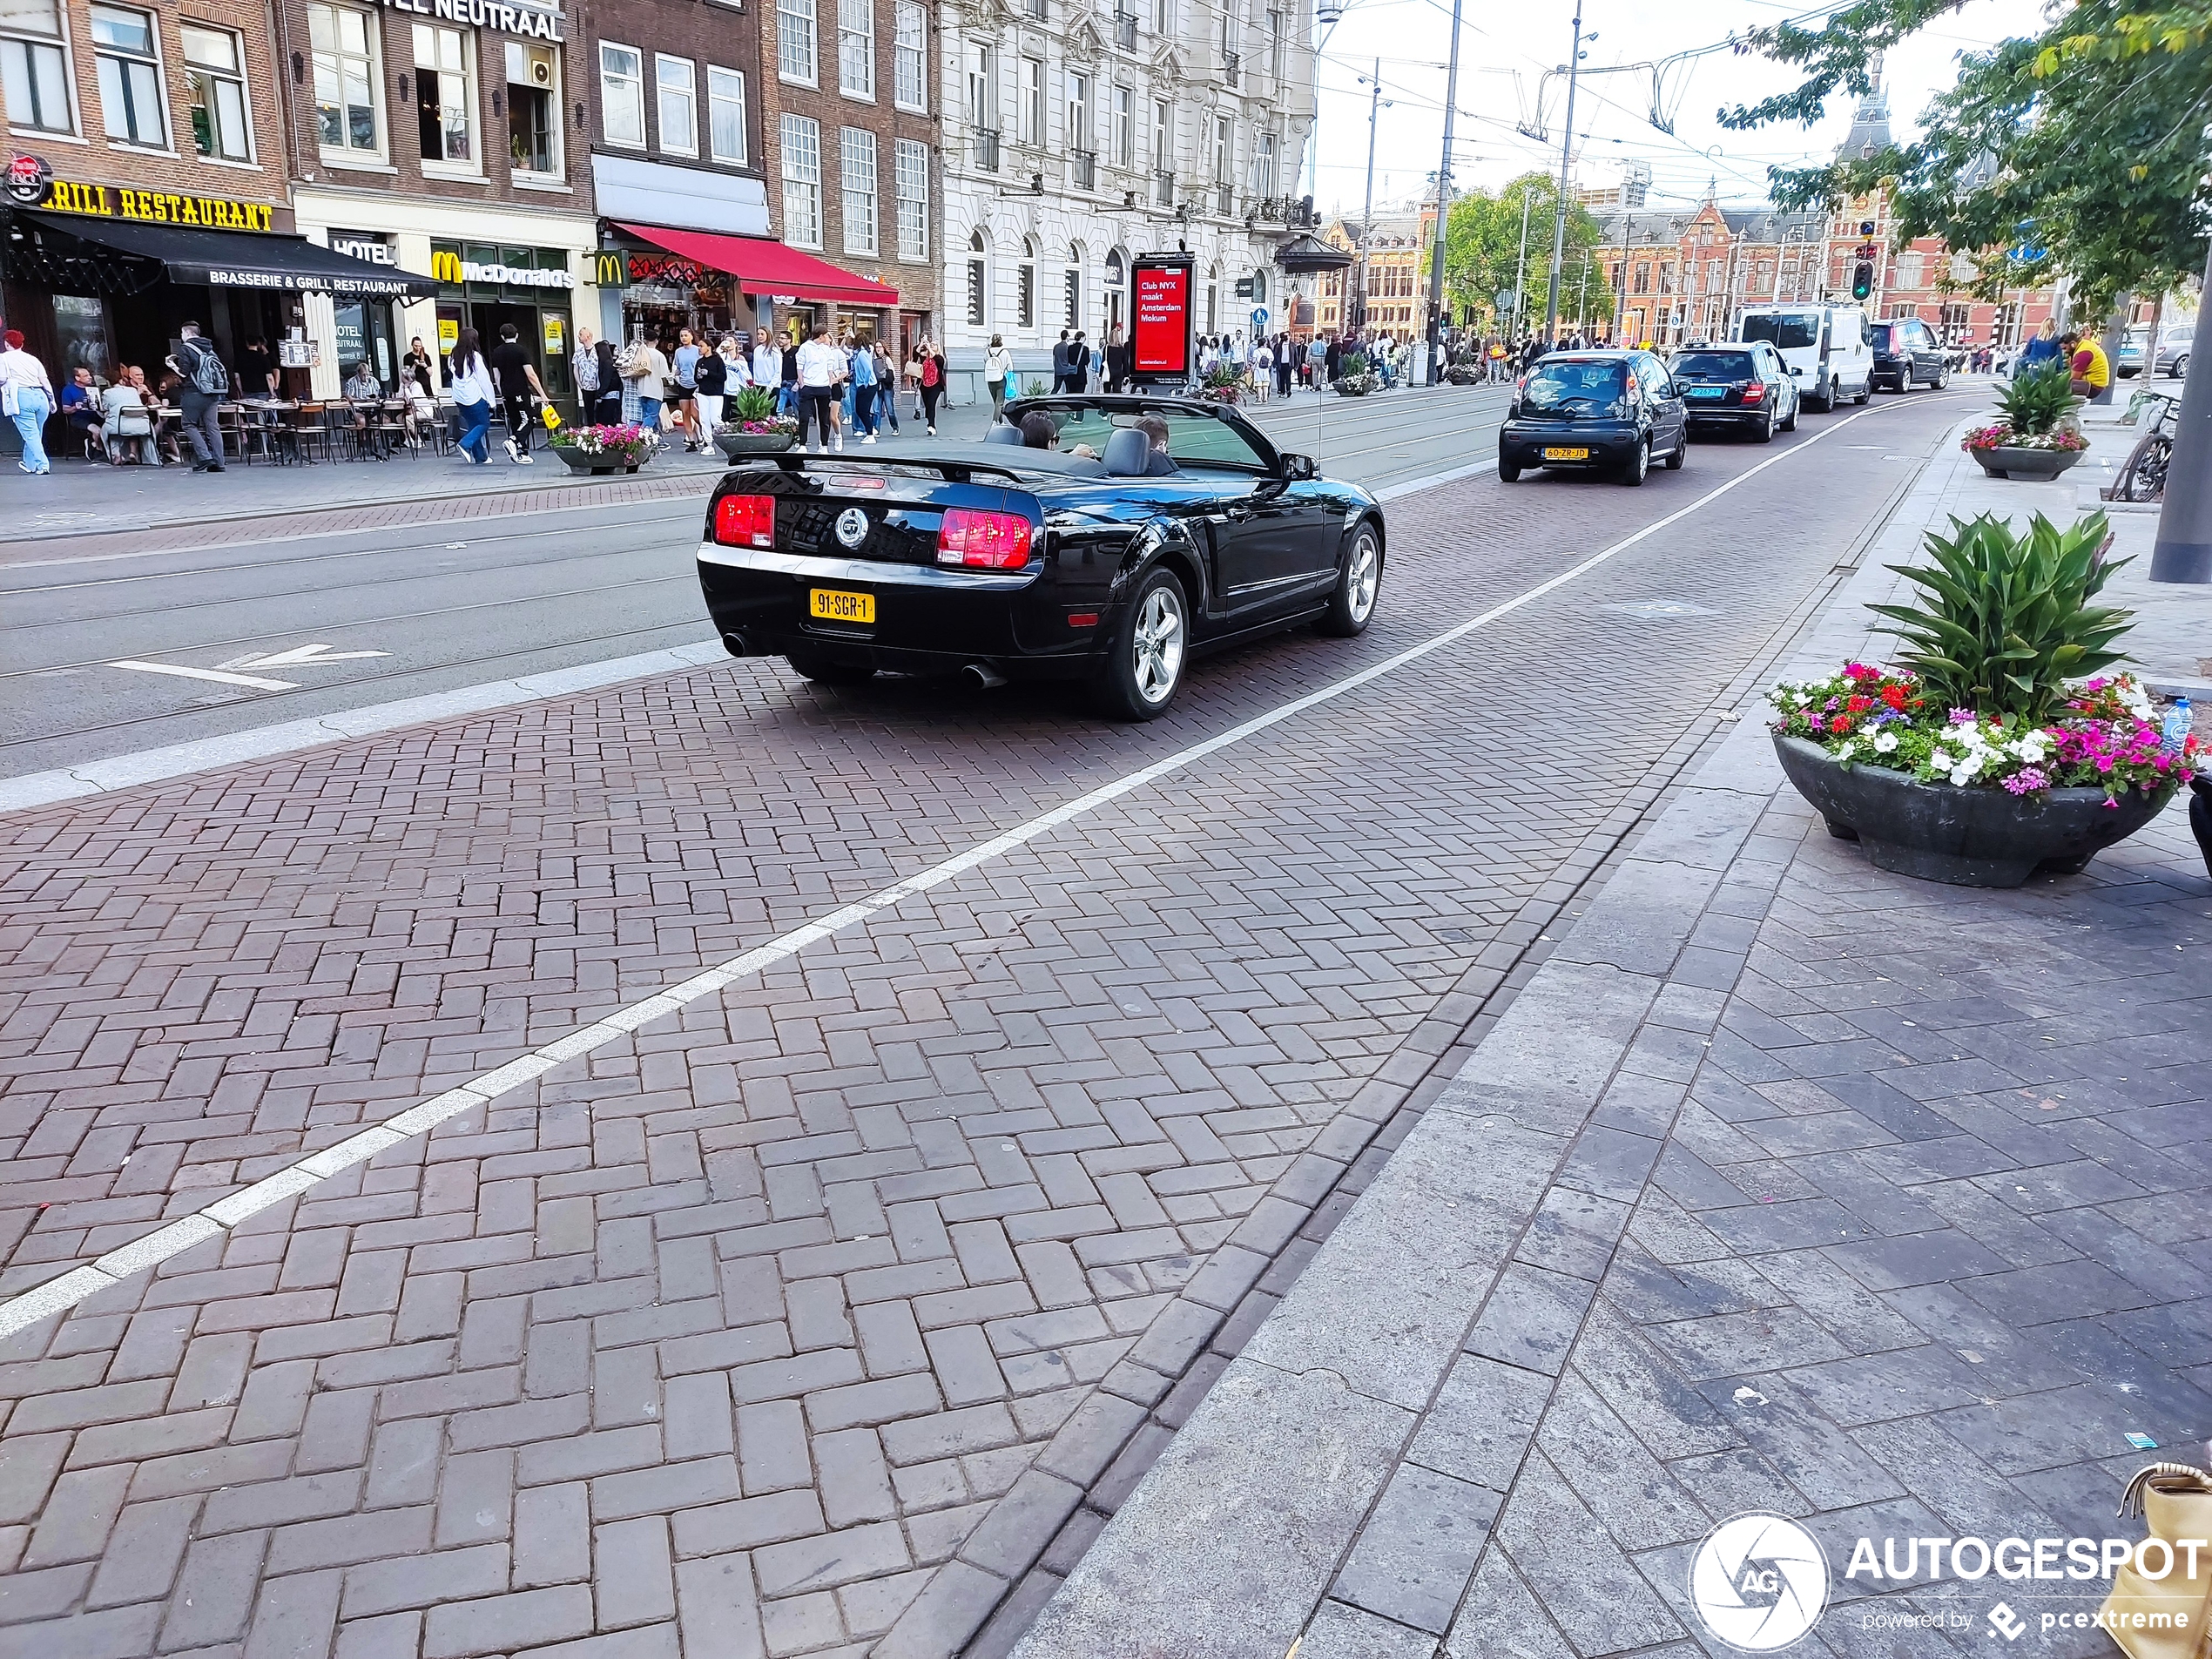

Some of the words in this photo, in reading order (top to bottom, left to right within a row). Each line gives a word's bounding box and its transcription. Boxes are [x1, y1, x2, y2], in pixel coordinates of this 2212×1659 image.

[435, 0, 563, 43] NEUTRAAL
[40, 180, 112, 216] RILL
[118, 189, 273, 232] RESTAURANT
[334, 240, 395, 265] HOTEL
[462, 261, 576, 289] McDonald's
[210, 271, 282, 287] BRASSERIE
[285, 277, 294, 288] &
[296, 276, 332, 290] GRILL
[334, 279, 408, 294] RESTAURANT
[1141, 281, 1157, 290] Club
[1159, 281, 1177, 290] NYX
[1141, 293, 1163, 301] maakt
[1141, 303, 1182, 312] Amsterdam
[1141, 314, 1167, 323] Mokum
[335, 325, 361, 337] OTEL
[336, 339, 363, 348] EUTRAAL
[1548, 448, 1585, 457] 60-ZR-JD
[818, 593, 867, 617] 91-SGR-1
